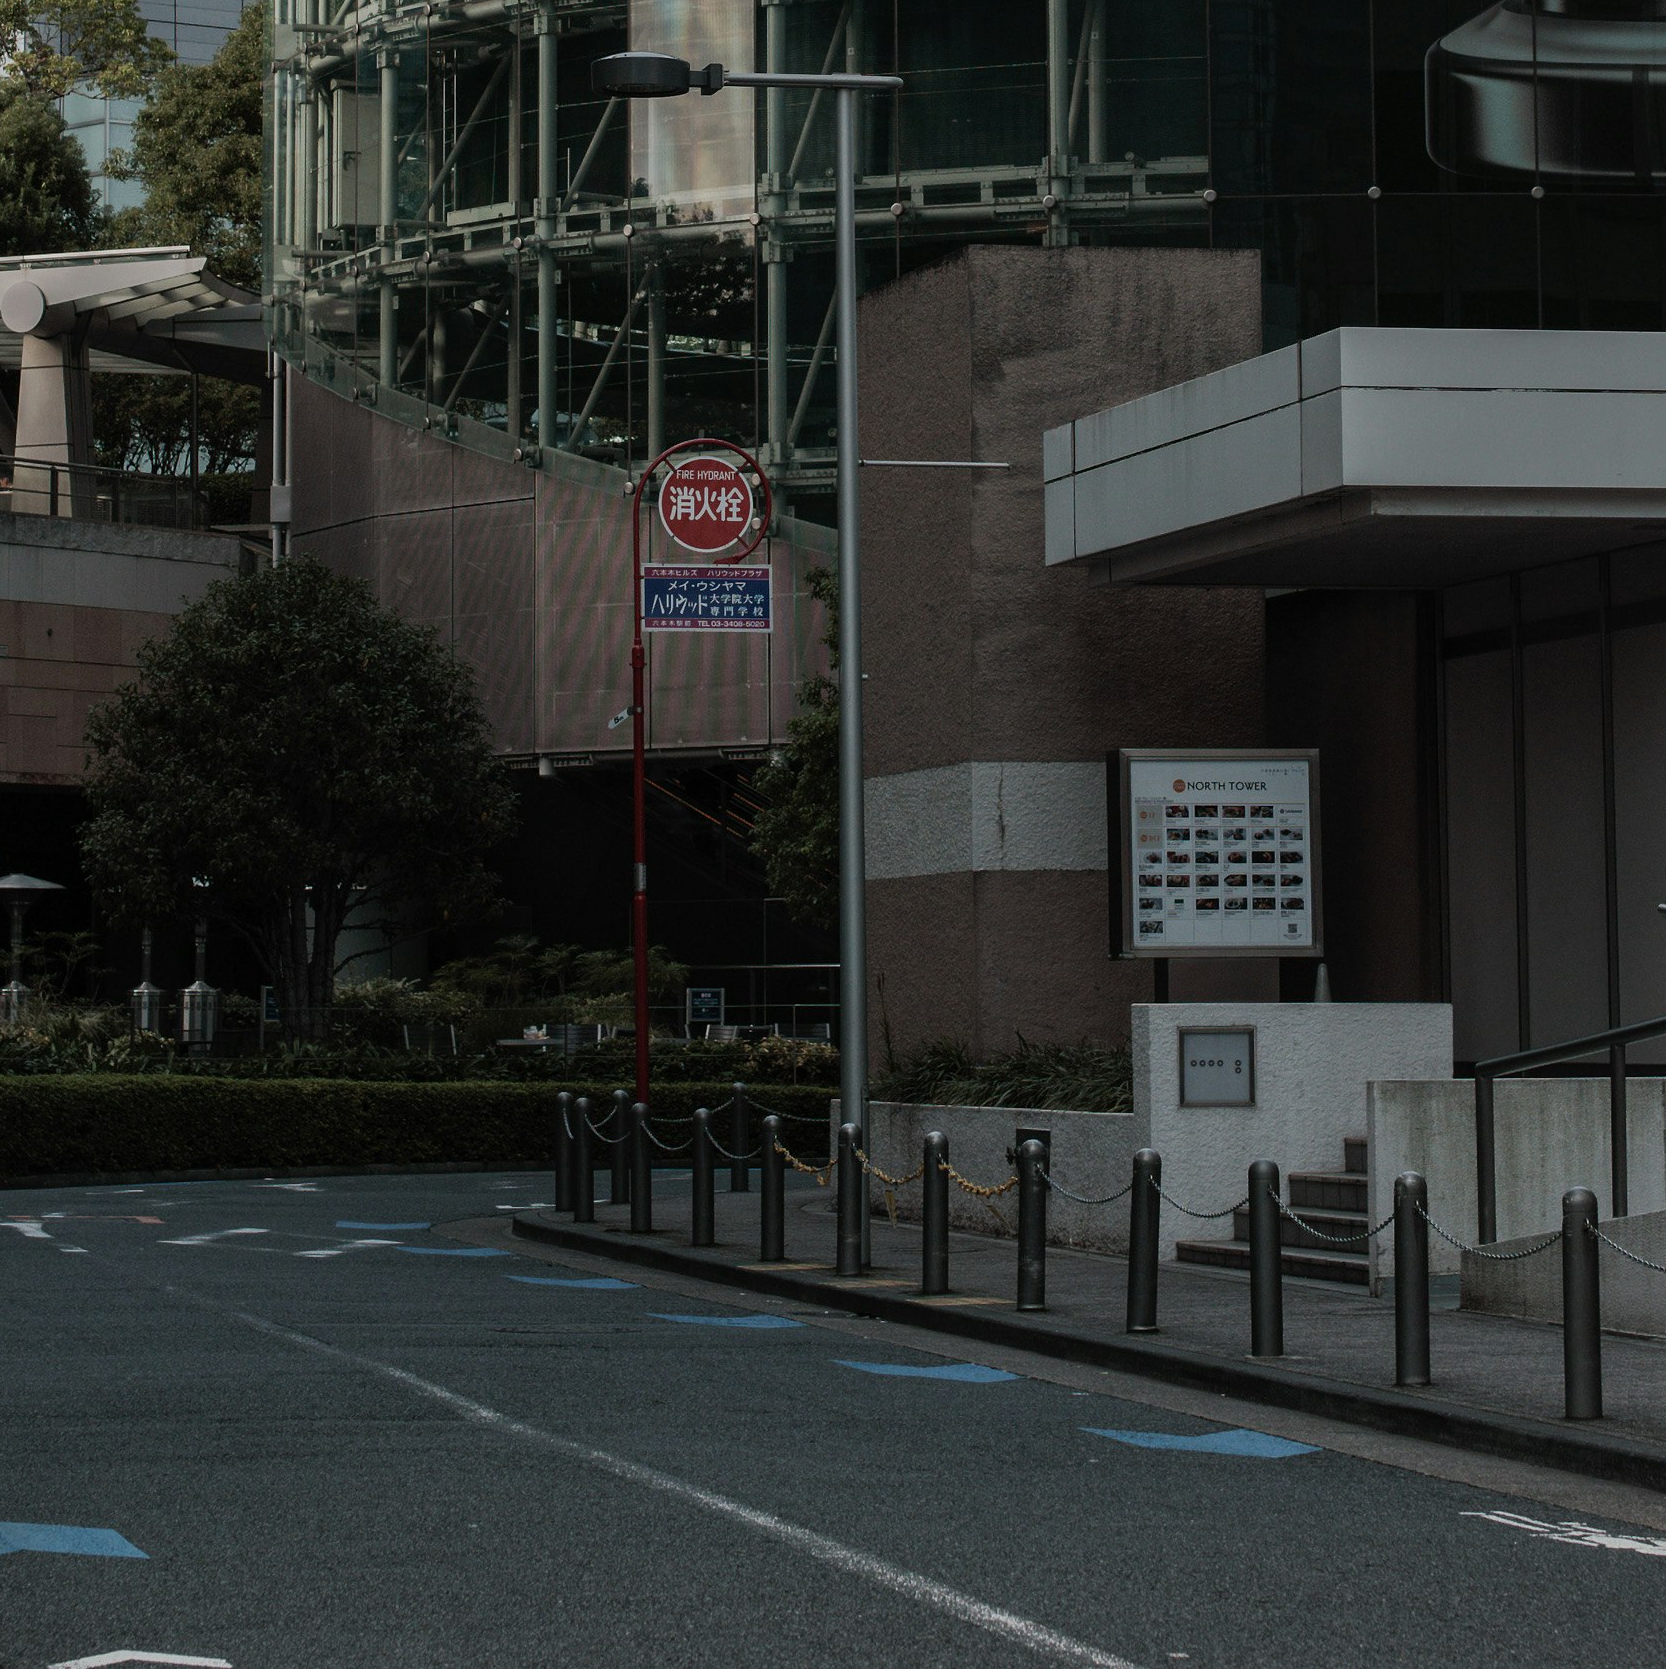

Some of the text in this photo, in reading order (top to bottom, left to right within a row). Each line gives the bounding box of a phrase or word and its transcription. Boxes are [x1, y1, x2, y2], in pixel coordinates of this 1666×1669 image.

[676, 469, 736, 481] FIRE HYDRANT
[669, 485, 745, 522] 消火栓
[651, 569, 763, 578] 六本木ヒルズ ハリウッドプラザ
[668, 581, 747, 592] メイ・ウシヤマ
[651, 594, 708, 615] ハリウッド
[709, 594, 765, 605] 大学院大学
[697, 620, 710, 628] TEL
[1187, 781, 1226, 791] NORTH
[1229, 781, 1267, 791] TOWER
